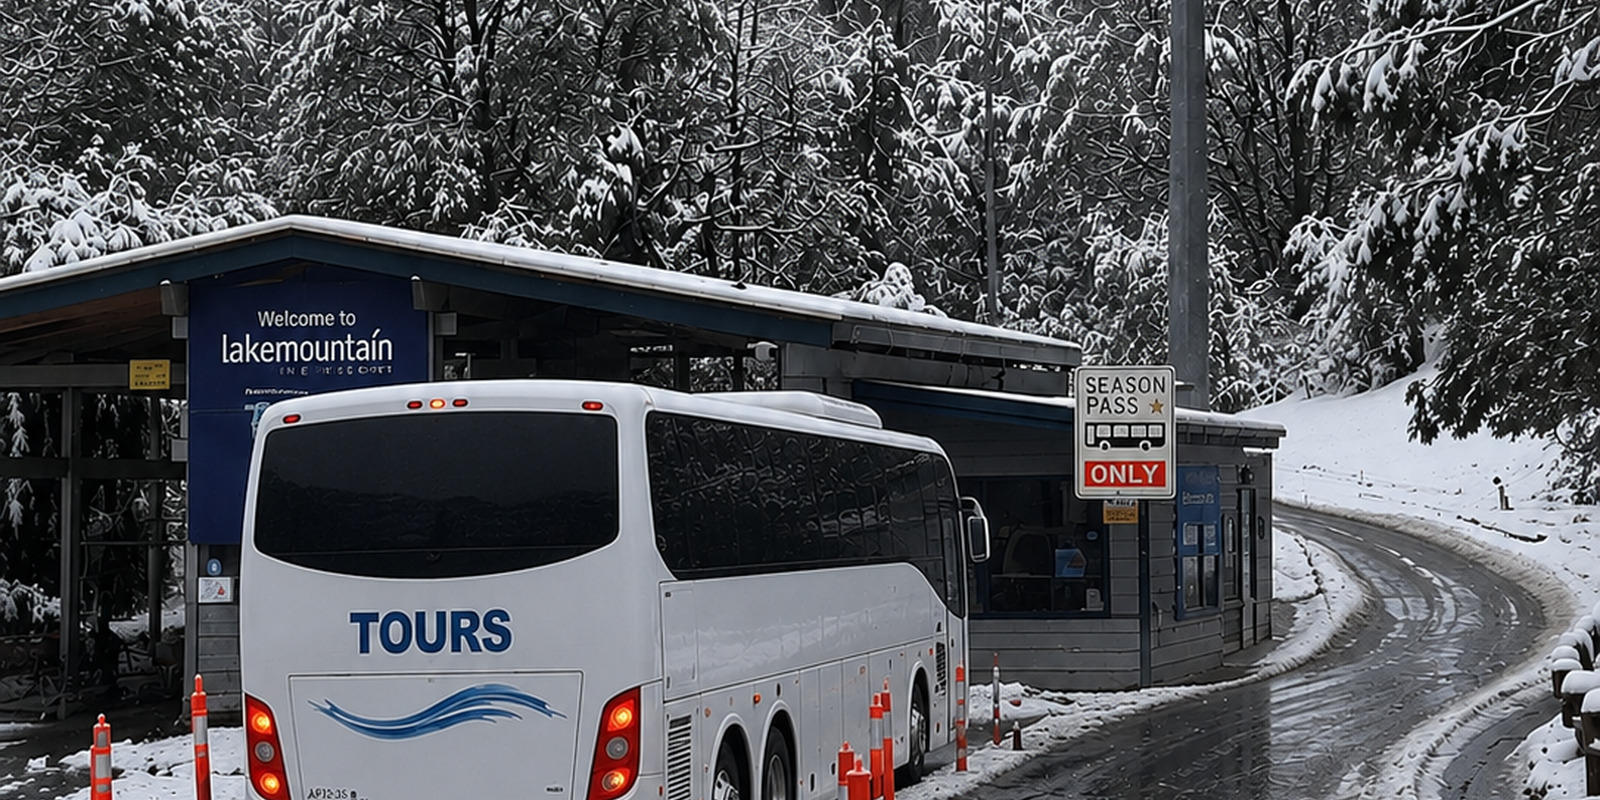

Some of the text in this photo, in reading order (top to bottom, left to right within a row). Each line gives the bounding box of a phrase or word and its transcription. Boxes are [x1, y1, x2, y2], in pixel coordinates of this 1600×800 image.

[257, 310, 356, 327] Welcome to
[1085, 376, 1166, 394] SEASON
[1086, 396, 1139, 415] PASS
[1090, 463, 1159, 484] ONLY
[349, 608, 512, 654] TOURS
